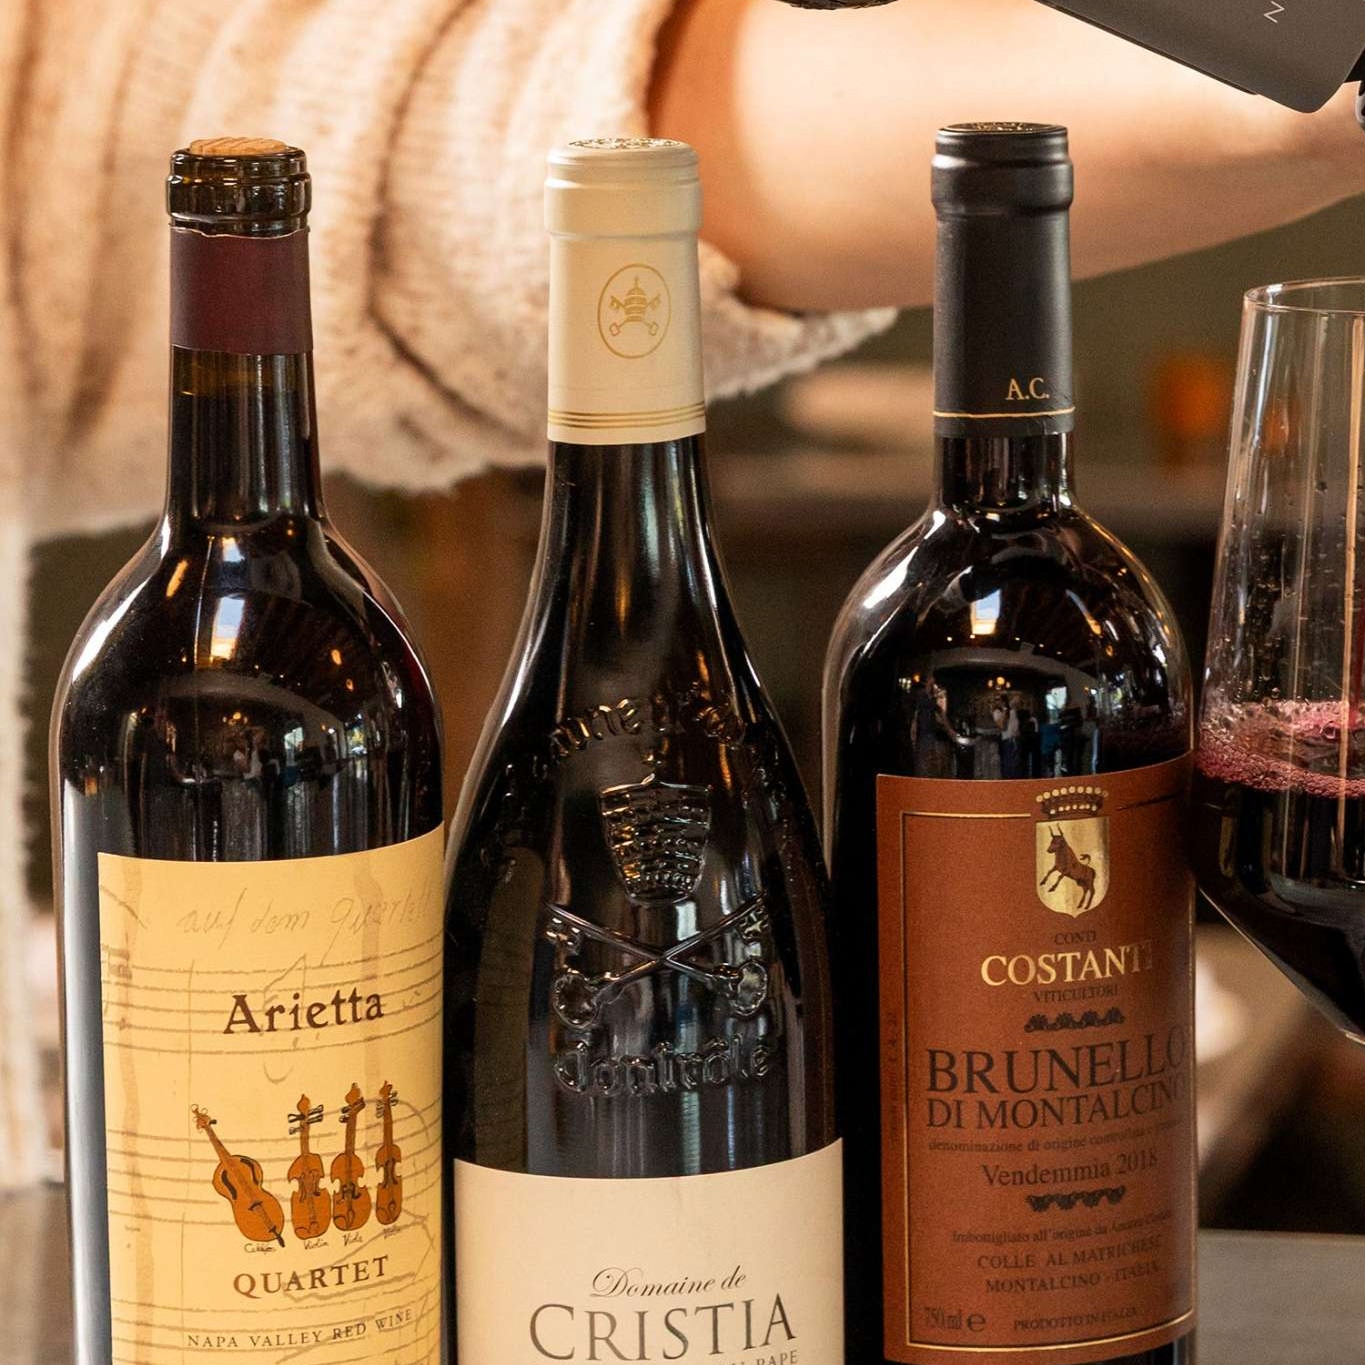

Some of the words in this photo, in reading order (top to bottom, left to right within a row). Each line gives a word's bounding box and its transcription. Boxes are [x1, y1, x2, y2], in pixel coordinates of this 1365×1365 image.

[1005, 377, 1050, 401] A.C.
[223, 987, 385, 1034] Arietta
[926, 1026, 1185, 1095] BRUNELLO
[926, 1097, 965, 1129] DI
[981, 1161, 1111, 1187] Vendemmia
[976, 1254, 1035, 1269] COLLE
[1046, 1250, 1068, 1267] AL
[233, 1255, 388, 1299] QUARTET
[589, 1266, 716, 1298] Domaine
[721, 1265, 746, 1290] de
[985, 1271, 1101, 1294] MONTALCINO
[187, 1335, 238, 1348] NAPA
[249, 1330, 323, 1348] VALLEY
[332, 1321, 367, 1341] RED
[375, 1308, 413, 1331] WINE
[529, 1293, 798, 1361] CRISTIA
